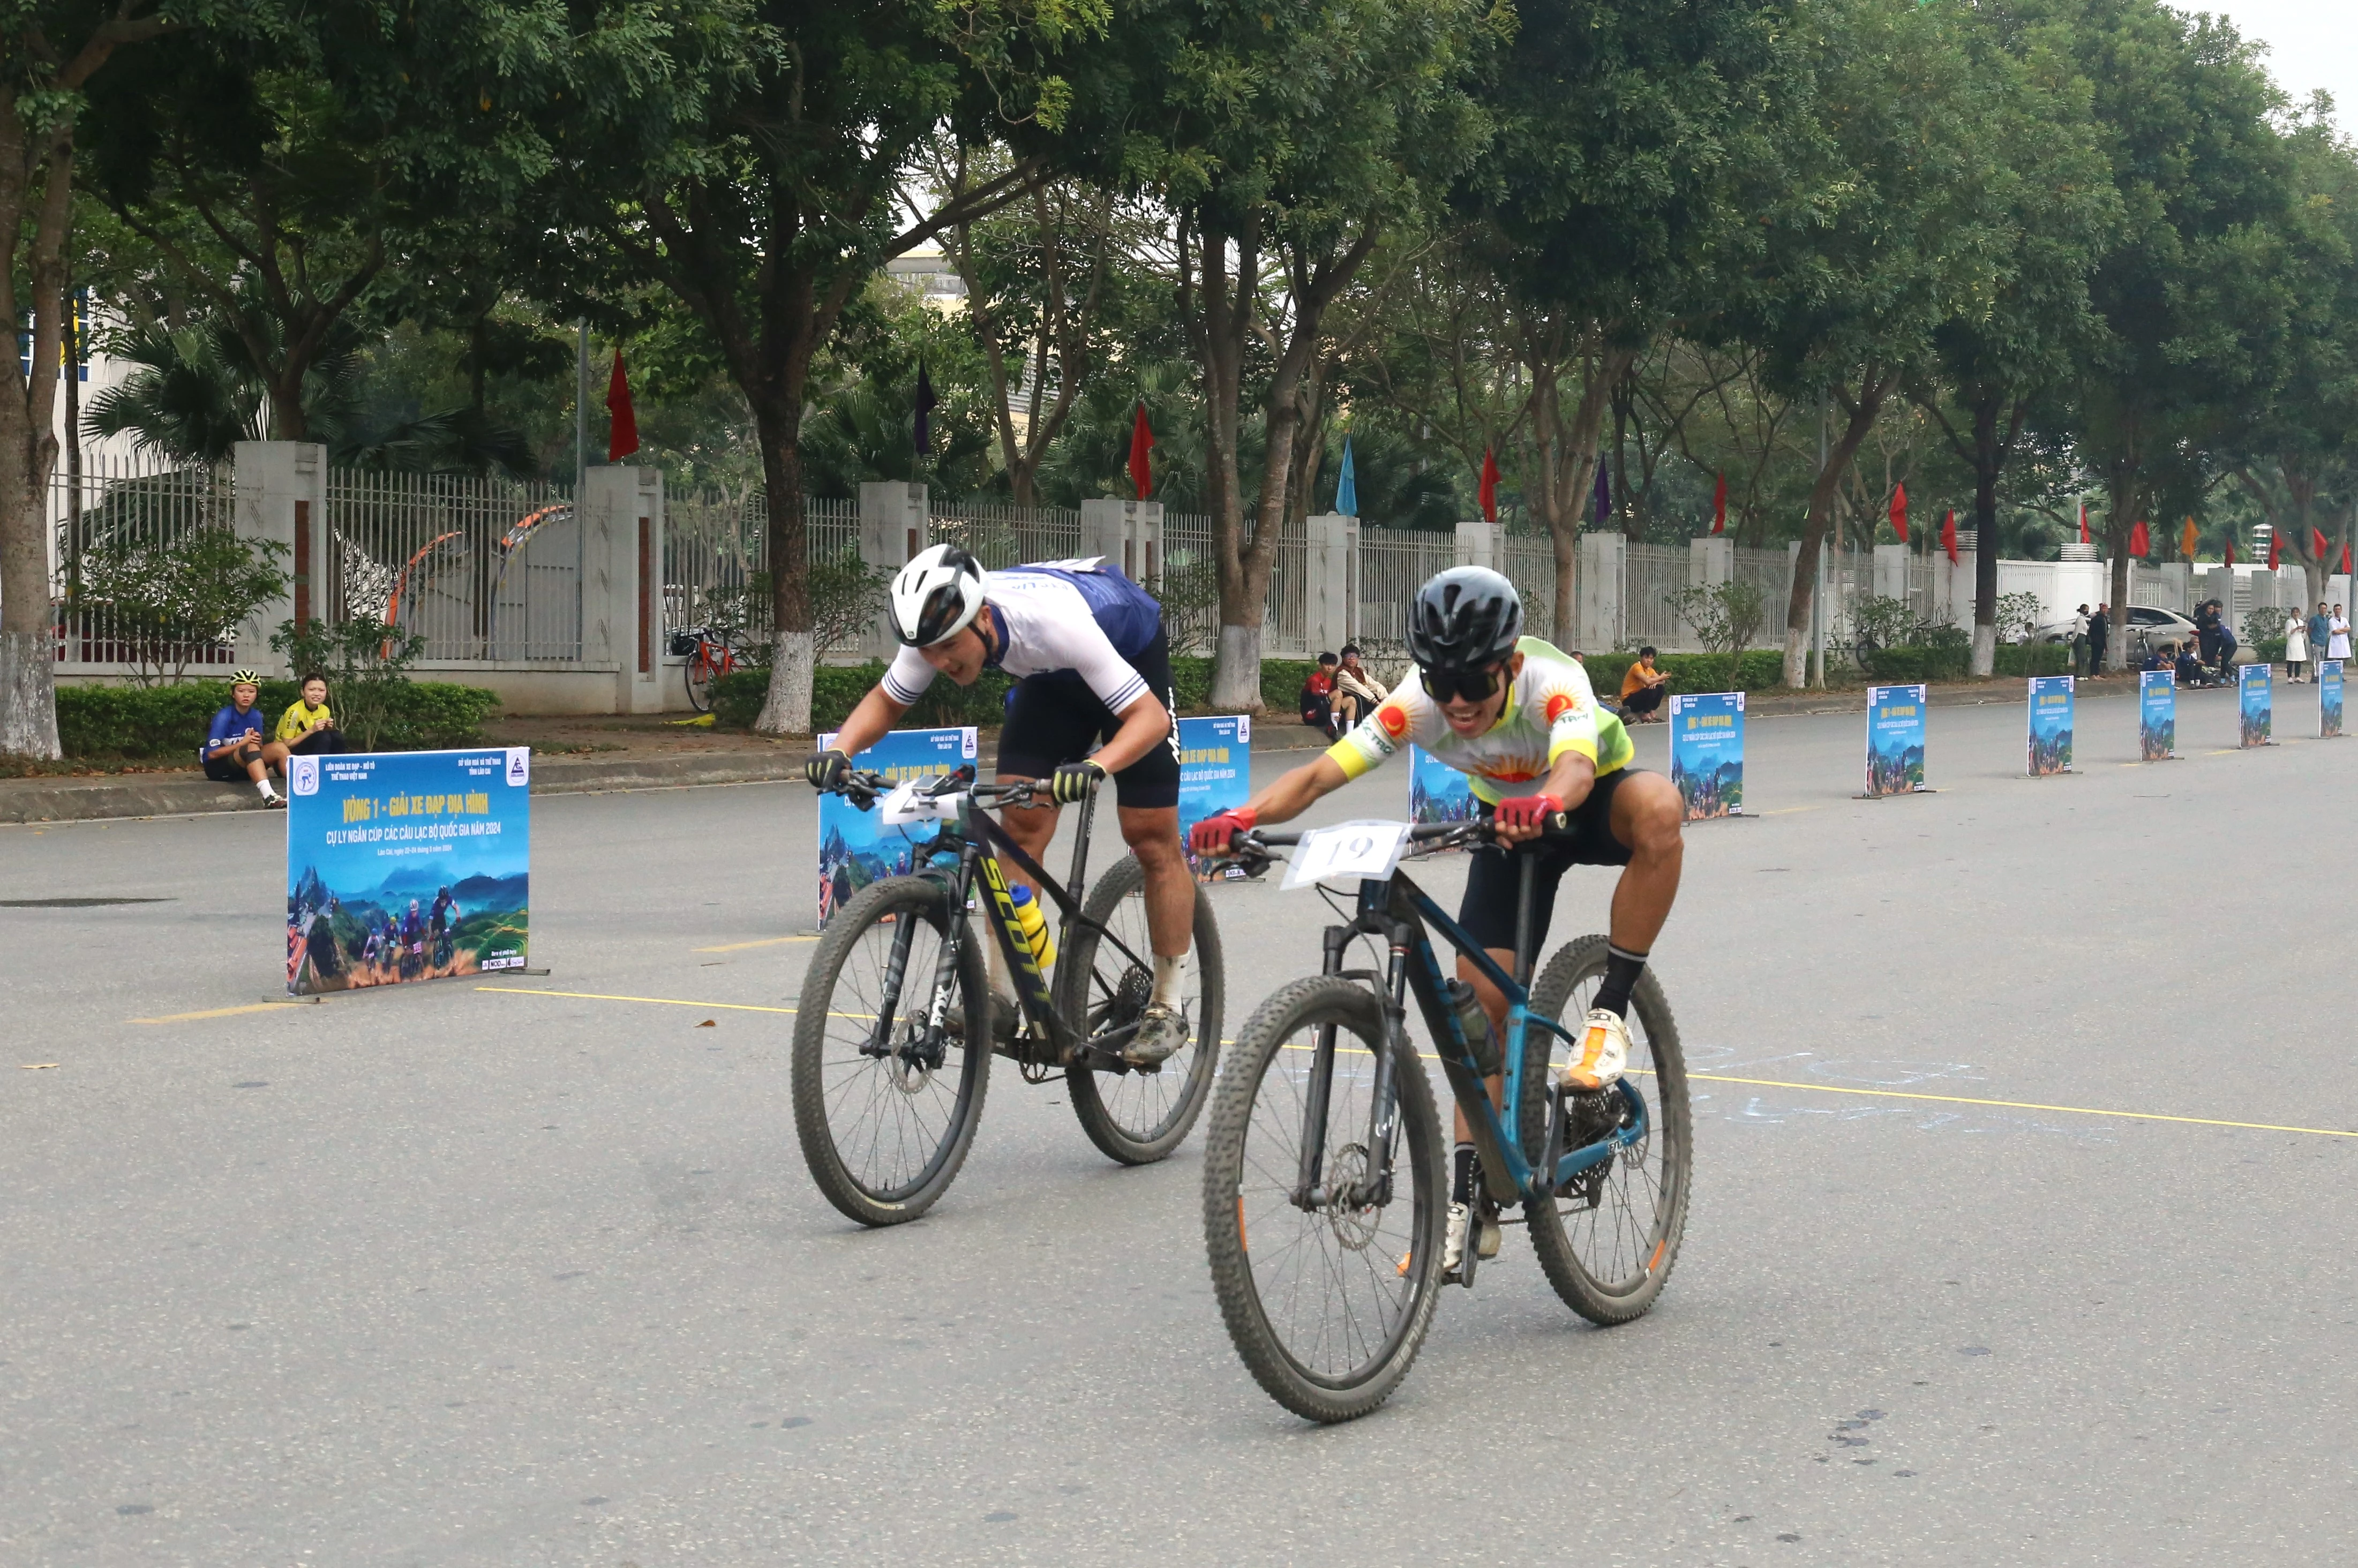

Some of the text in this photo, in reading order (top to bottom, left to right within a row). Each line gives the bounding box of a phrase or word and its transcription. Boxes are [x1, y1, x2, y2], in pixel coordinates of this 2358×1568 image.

[343, 794, 370, 824] VÒNG
[373, 798, 378, 818] 1
[389, 790, 409, 817] GIẢI
[410, 796, 424, 815] XE
[426, 795, 445, 819] ĐẠP
[447, 794, 464, 819] ĐỊA
[465, 789, 489, 815] HÌNH
[326, 820, 501, 847] CỰ LY NGẮN CÚP CÁC CÂU LẠC BỘ QUỐC GIA NĂM 2024
[1325, 836, 1374, 866] 19
[979, 856, 1054, 1010] SCOTT
[929, 984, 952, 1029] FOX
